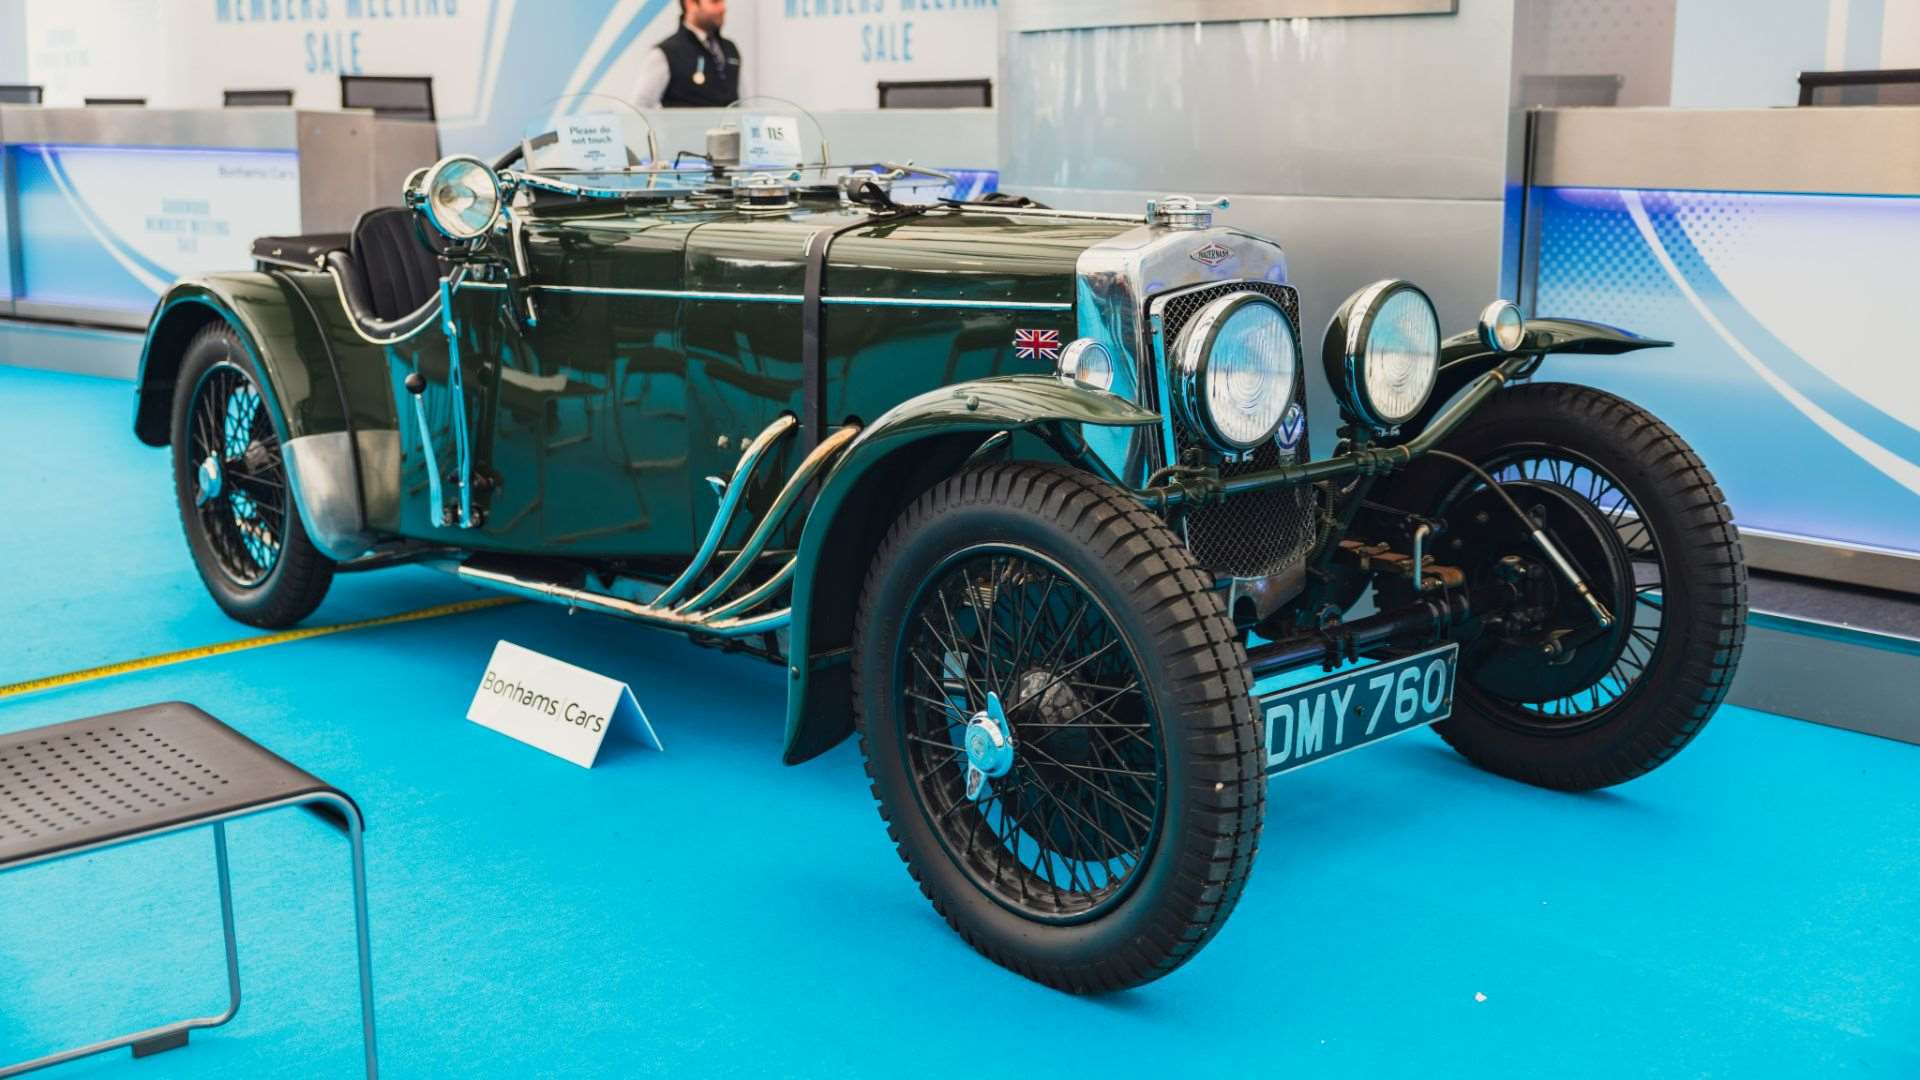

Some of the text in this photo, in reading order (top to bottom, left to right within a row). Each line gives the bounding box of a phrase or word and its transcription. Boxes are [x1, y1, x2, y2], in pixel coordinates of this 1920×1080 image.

[305, 31, 363, 74] SALE
[862, 23, 913, 62] SALE
[482, 671, 605, 733] Bonhams Cars
[1265, 658, 1447, 768] DMY 760
